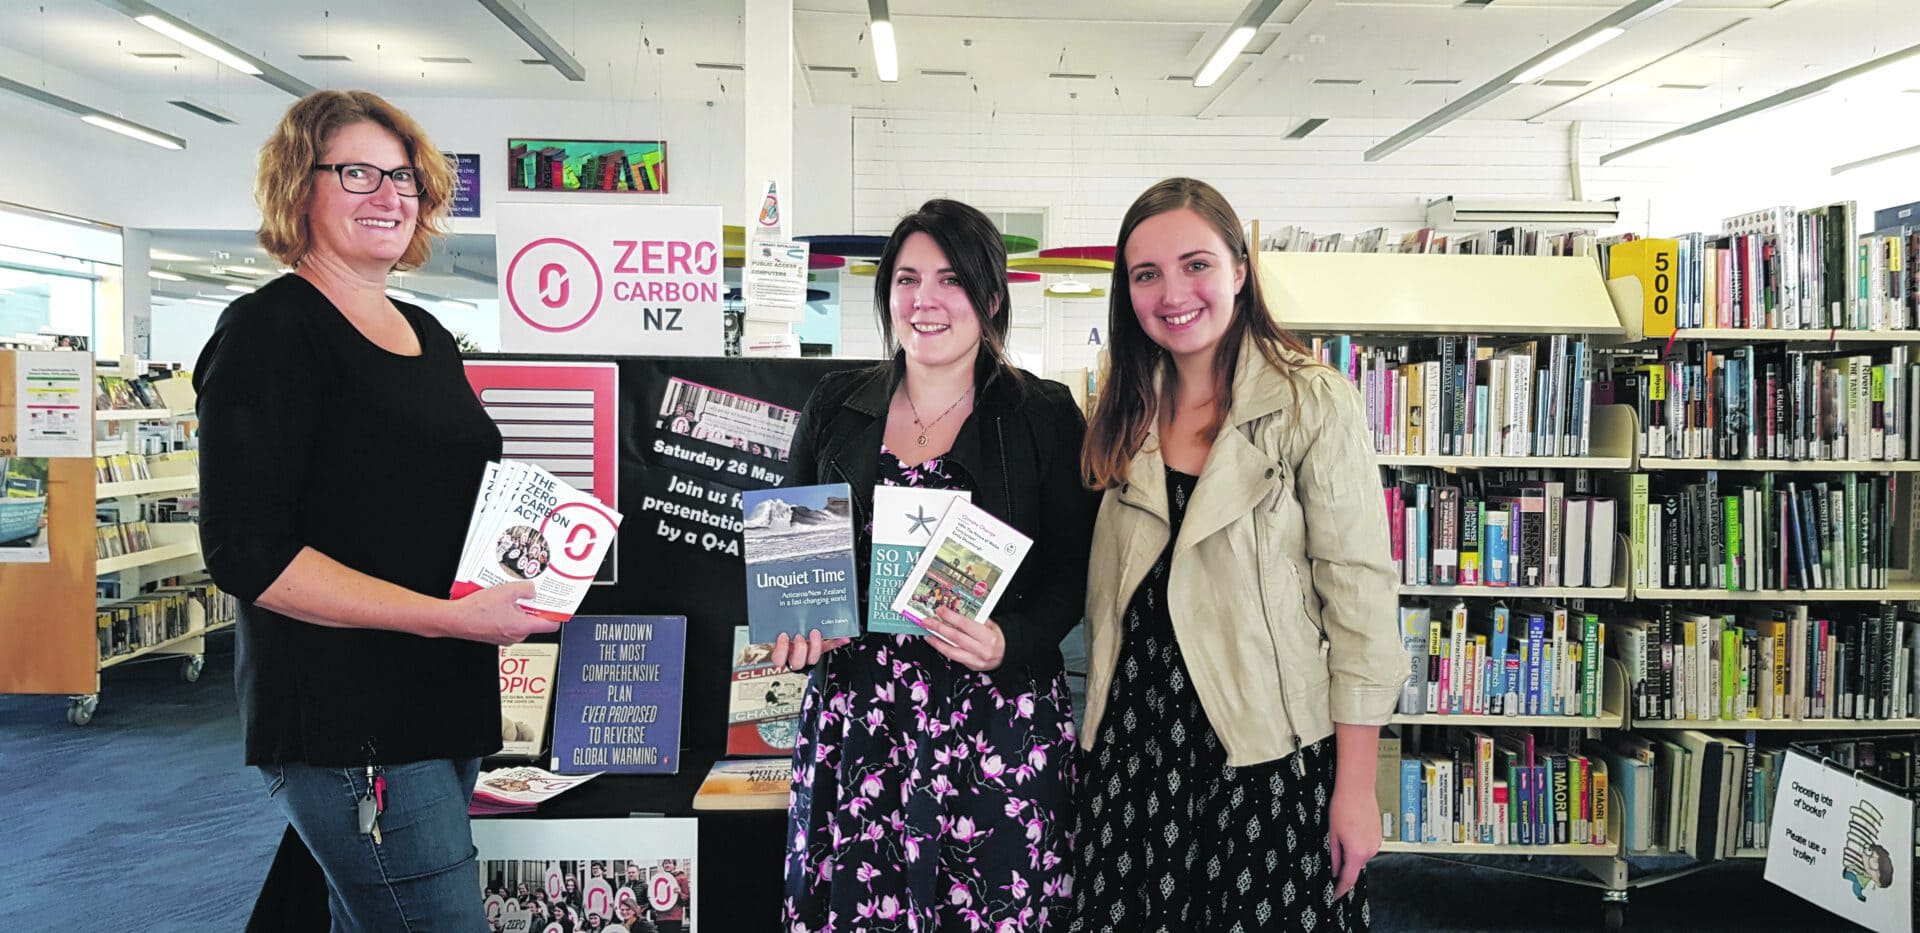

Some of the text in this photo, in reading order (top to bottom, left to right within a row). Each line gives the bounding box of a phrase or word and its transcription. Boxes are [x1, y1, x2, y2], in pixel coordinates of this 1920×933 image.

[613, 240, 718, 275] ZERO
[613, 282, 718, 302] CARBON
[643, 308, 683, 331] NZ
[1088, 327, 1101, 346] A
[1445, 341, 1453, 394] THE ODYSSEY
[1429, 365, 1438, 410] MYTHOS
[1861, 365, 1870, 397] Rivers
[653, 440, 784, 487] Saturday 26 May
[533, 472, 557, 493] THE
[668, 475, 727, 505] Join us
[525, 483, 558, 507] ZERO
[514, 506, 541, 524] ACT
[520, 493, 571, 528] CARBON
[642, 496, 744, 533] presentatio
[657, 520, 739, 557] by a Q+A
[1531, 514, 1541, 567] DICTIONA
[1552, 523, 1560, 557] Dictionar
[876, 548, 899, 562] SO
[757, 568, 845, 588] Unquiet Time
[823, 587, 847, 596] Zealand
[874, 587, 896, 596] THE
[595, 623, 653, 641] DRAWDOWN
[600, 644, 646, 661] THE MOST
[500, 658, 530, 675] OT
[582, 664, 660, 682] COMPREHENSIVE
[737, 666, 790, 680] CLIMA
[1530, 639, 1540, 691] FRENCH VERBS
[1586, 642, 1595, 694] ITALIAN VERBS
[1881, 651, 1892, 694] WORL
[500, 677, 546, 694] OPIC
[1508, 673, 1517, 692] FREN
[607, 685, 632, 702] PLAN
[581, 705, 657, 723] EVER PROPOSED
[589, 727, 645, 744] TO REVERSE
[573, 747, 657, 765] GLOBAL WARMING
[1746, 743, 1755, 788] albatross
[1406, 775, 1416, 813] English-G
[1792, 781, 1833, 807] Choosing lots
[1794, 799, 1827, 819] of books?
[1786, 828, 1827, 855] Please use a
[1793, 847, 1816, 865] trolley!
